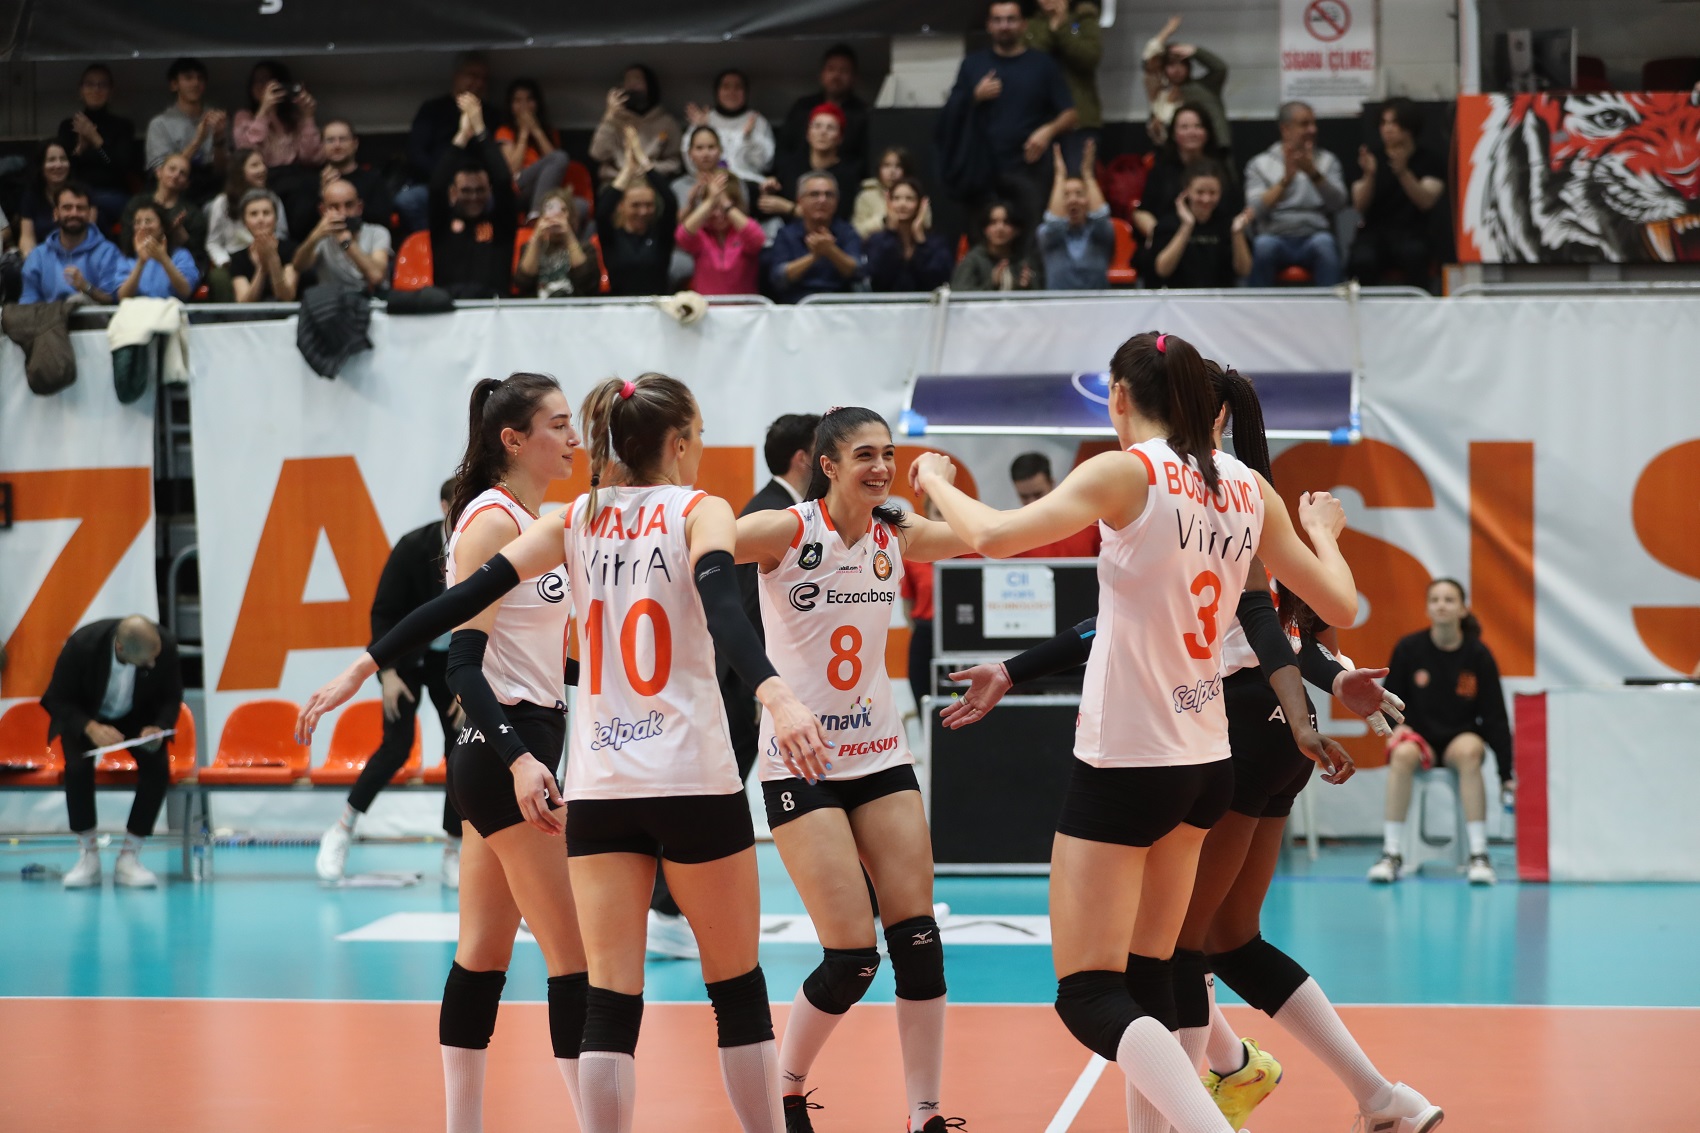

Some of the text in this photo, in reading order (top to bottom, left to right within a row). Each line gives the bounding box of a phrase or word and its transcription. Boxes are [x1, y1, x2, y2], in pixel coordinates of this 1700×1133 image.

[1163, 461, 1254, 515] BOSOVIC
[583, 503, 668, 541] MAJA
[1183, 569, 1222, 660] 3
[585, 597, 673, 697] 10
[826, 625, 863, 691] 8
[837, 736, 898, 757] PEGASUS
[780, 791, 796, 812] 8
